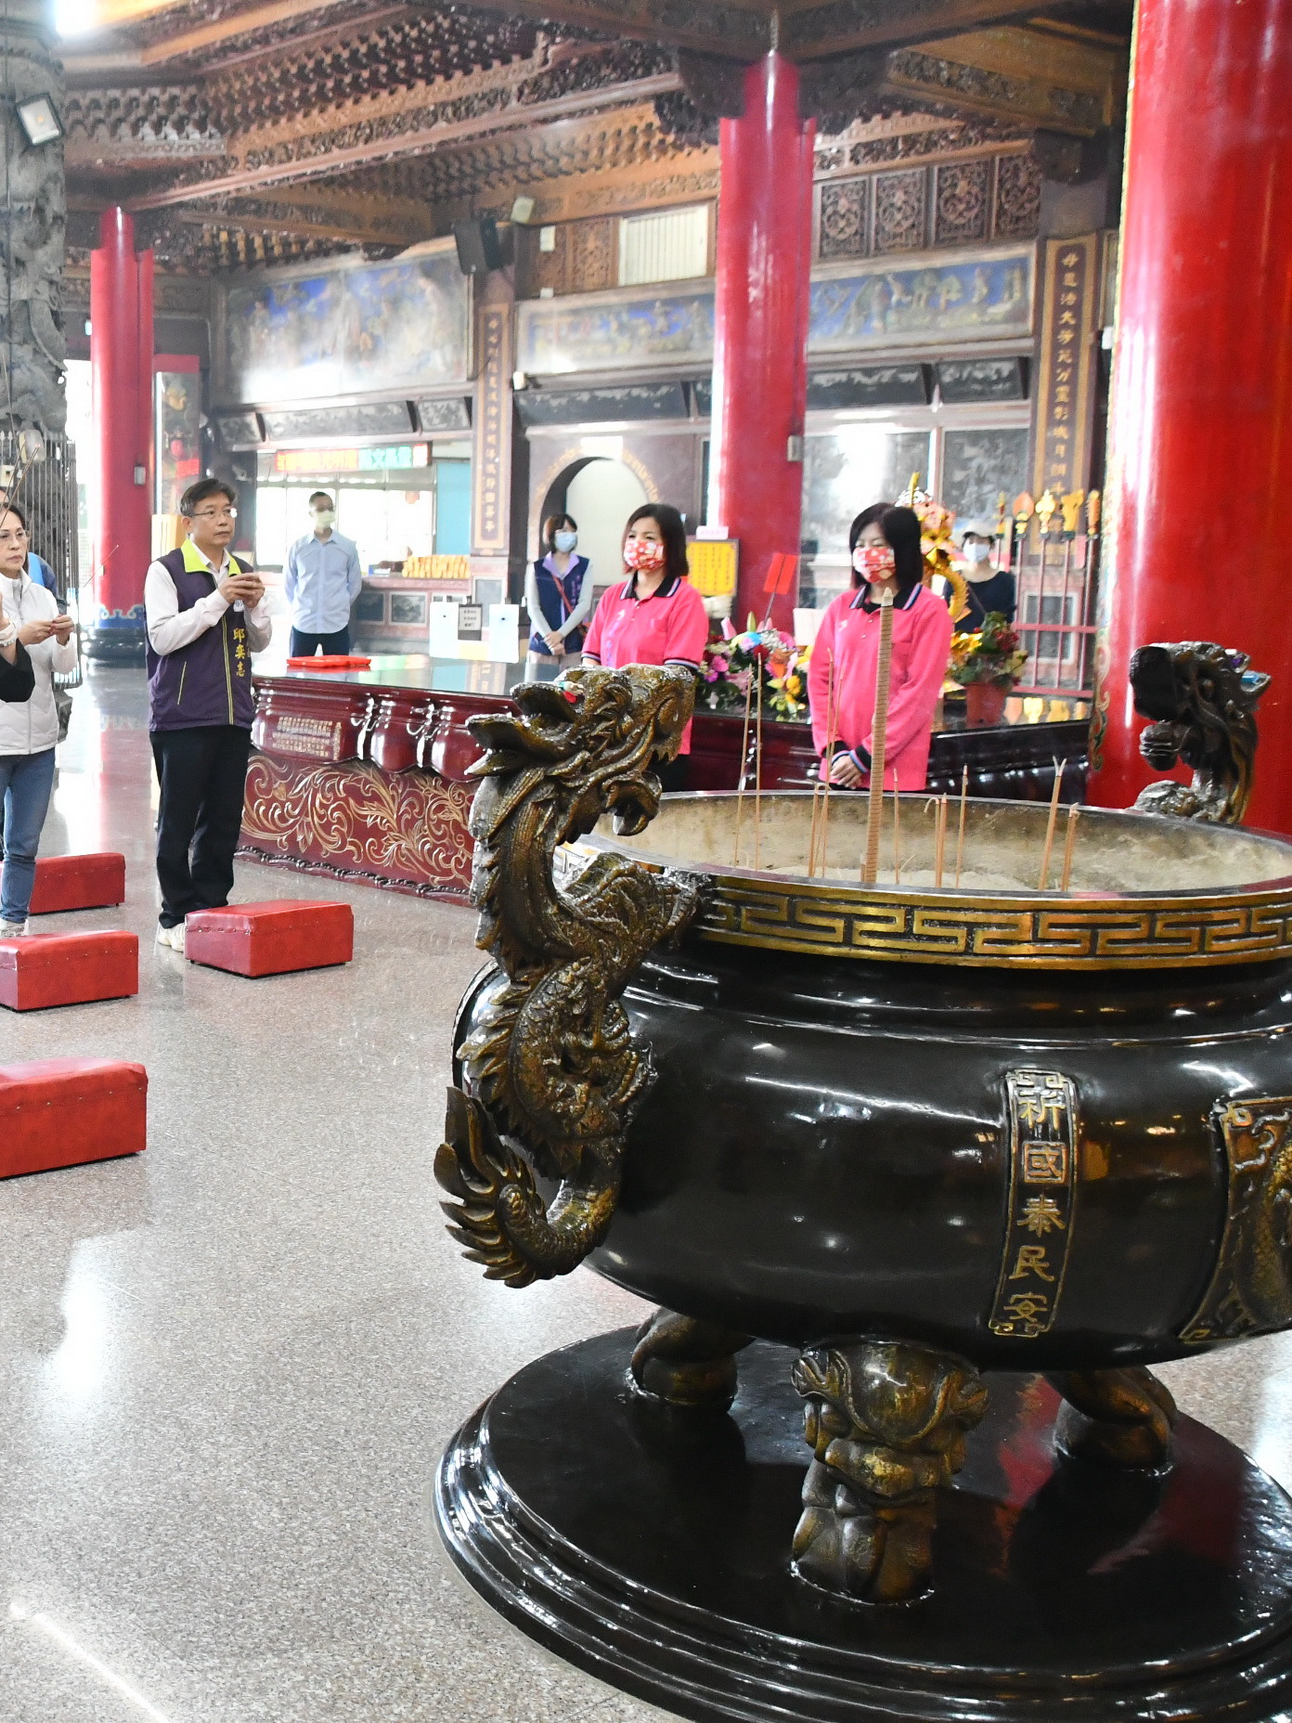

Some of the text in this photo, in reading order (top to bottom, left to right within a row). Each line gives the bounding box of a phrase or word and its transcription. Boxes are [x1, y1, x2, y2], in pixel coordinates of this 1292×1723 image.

[1004, 1090, 1066, 1322] 祈國泰民安
